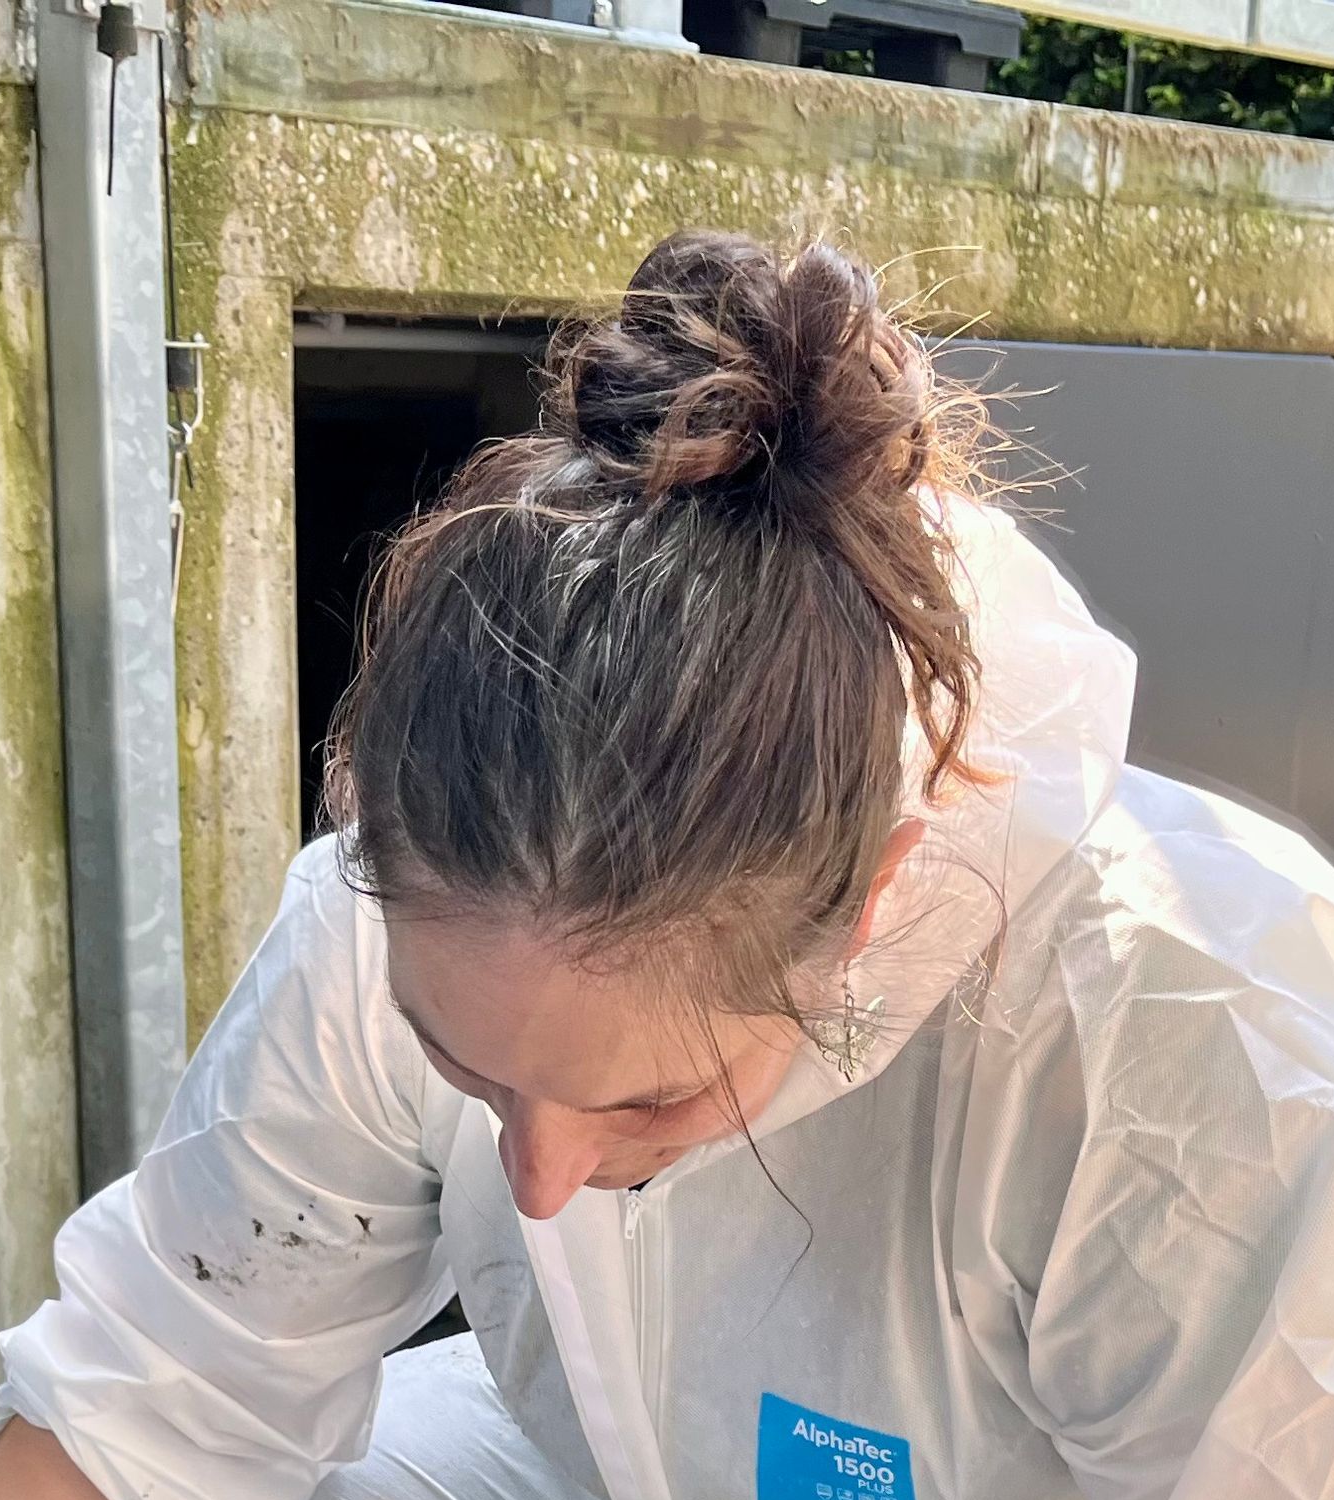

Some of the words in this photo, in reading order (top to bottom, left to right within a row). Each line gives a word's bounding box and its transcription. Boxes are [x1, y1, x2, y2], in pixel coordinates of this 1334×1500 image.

[792, 1418, 894, 1463] AlphaTec
[834, 1455, 895, 1485] 1500
[857, 1479, 894, 1495] PLUS
